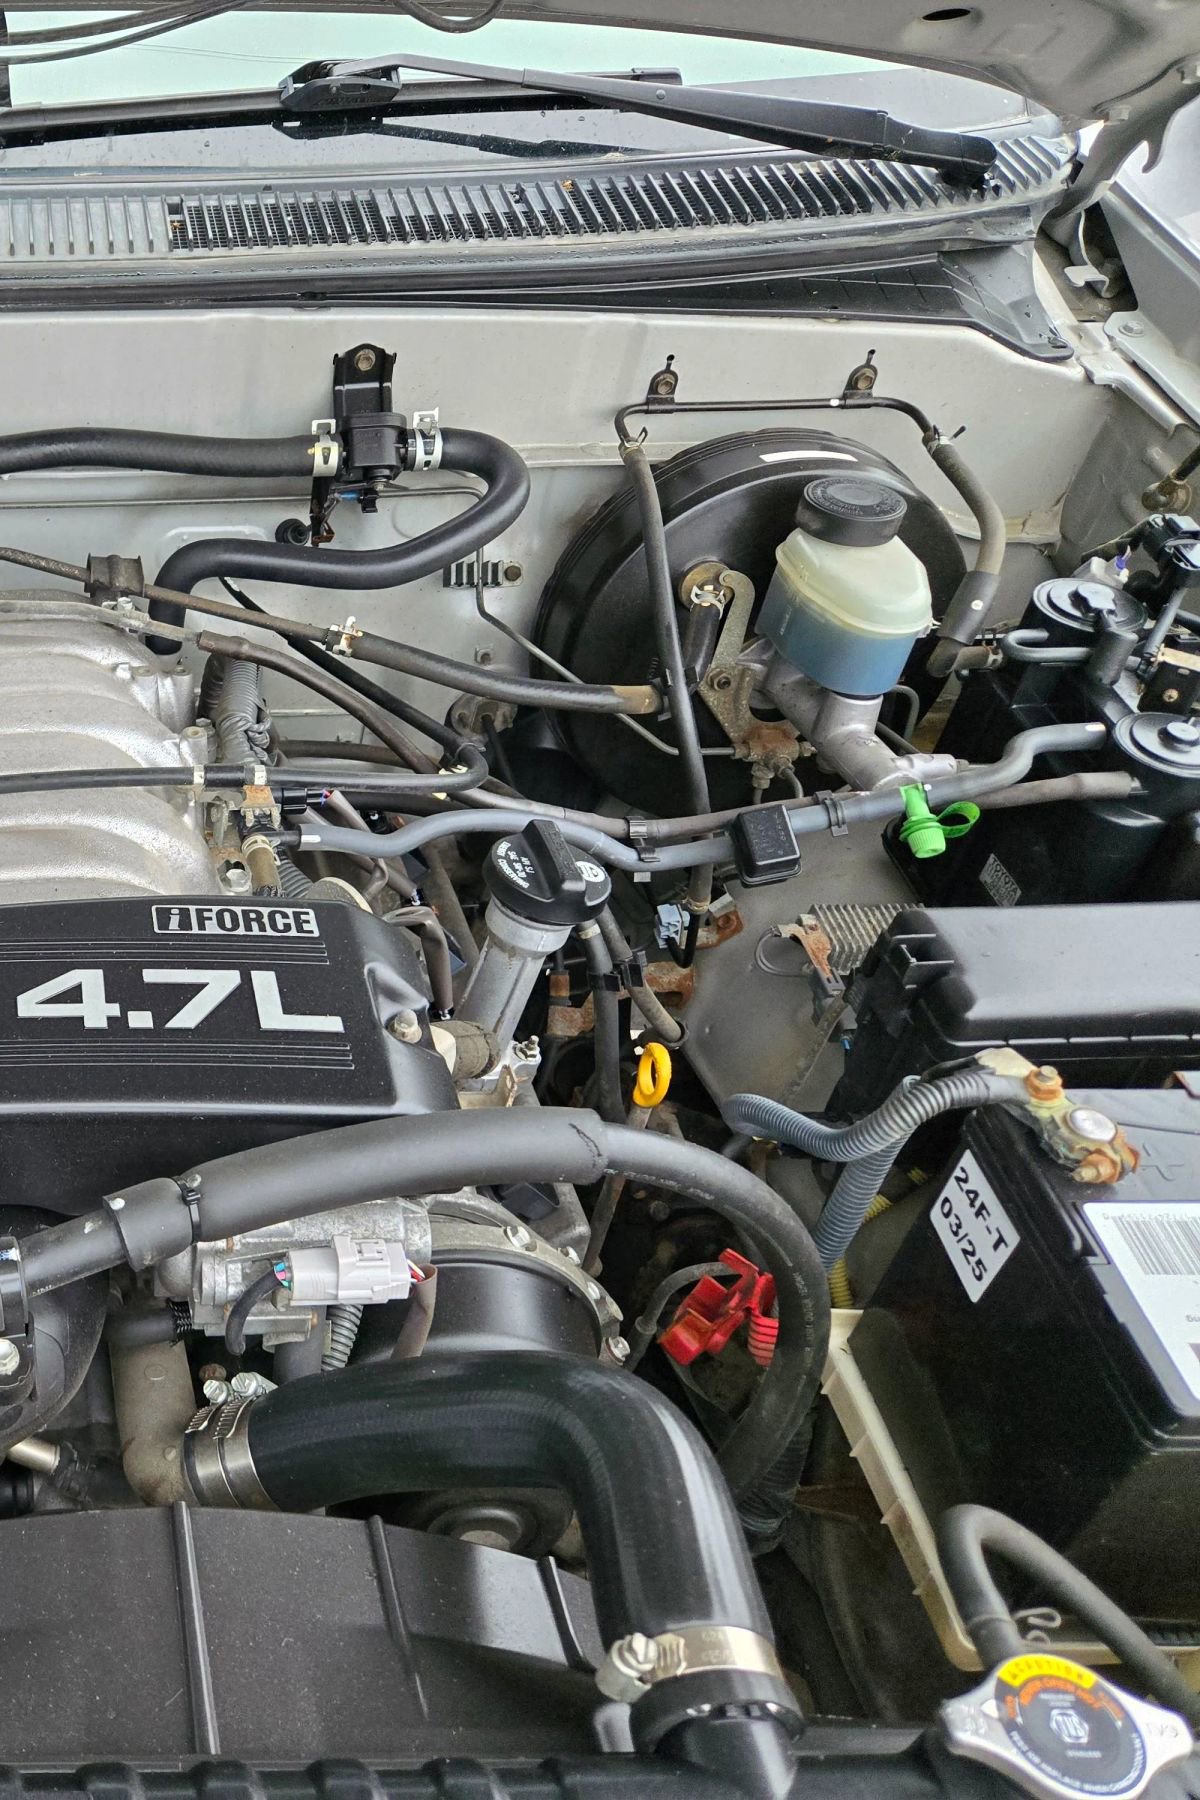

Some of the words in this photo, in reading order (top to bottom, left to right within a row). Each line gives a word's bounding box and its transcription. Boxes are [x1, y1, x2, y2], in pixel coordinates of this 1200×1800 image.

[992, 856, 1017, 893] TOYOTA
[16, 968, 346, 1033] 4.7L
[941, 1196, 987, 1282] 03/25
[954, 1166, 1008, 1252] 24F-T
